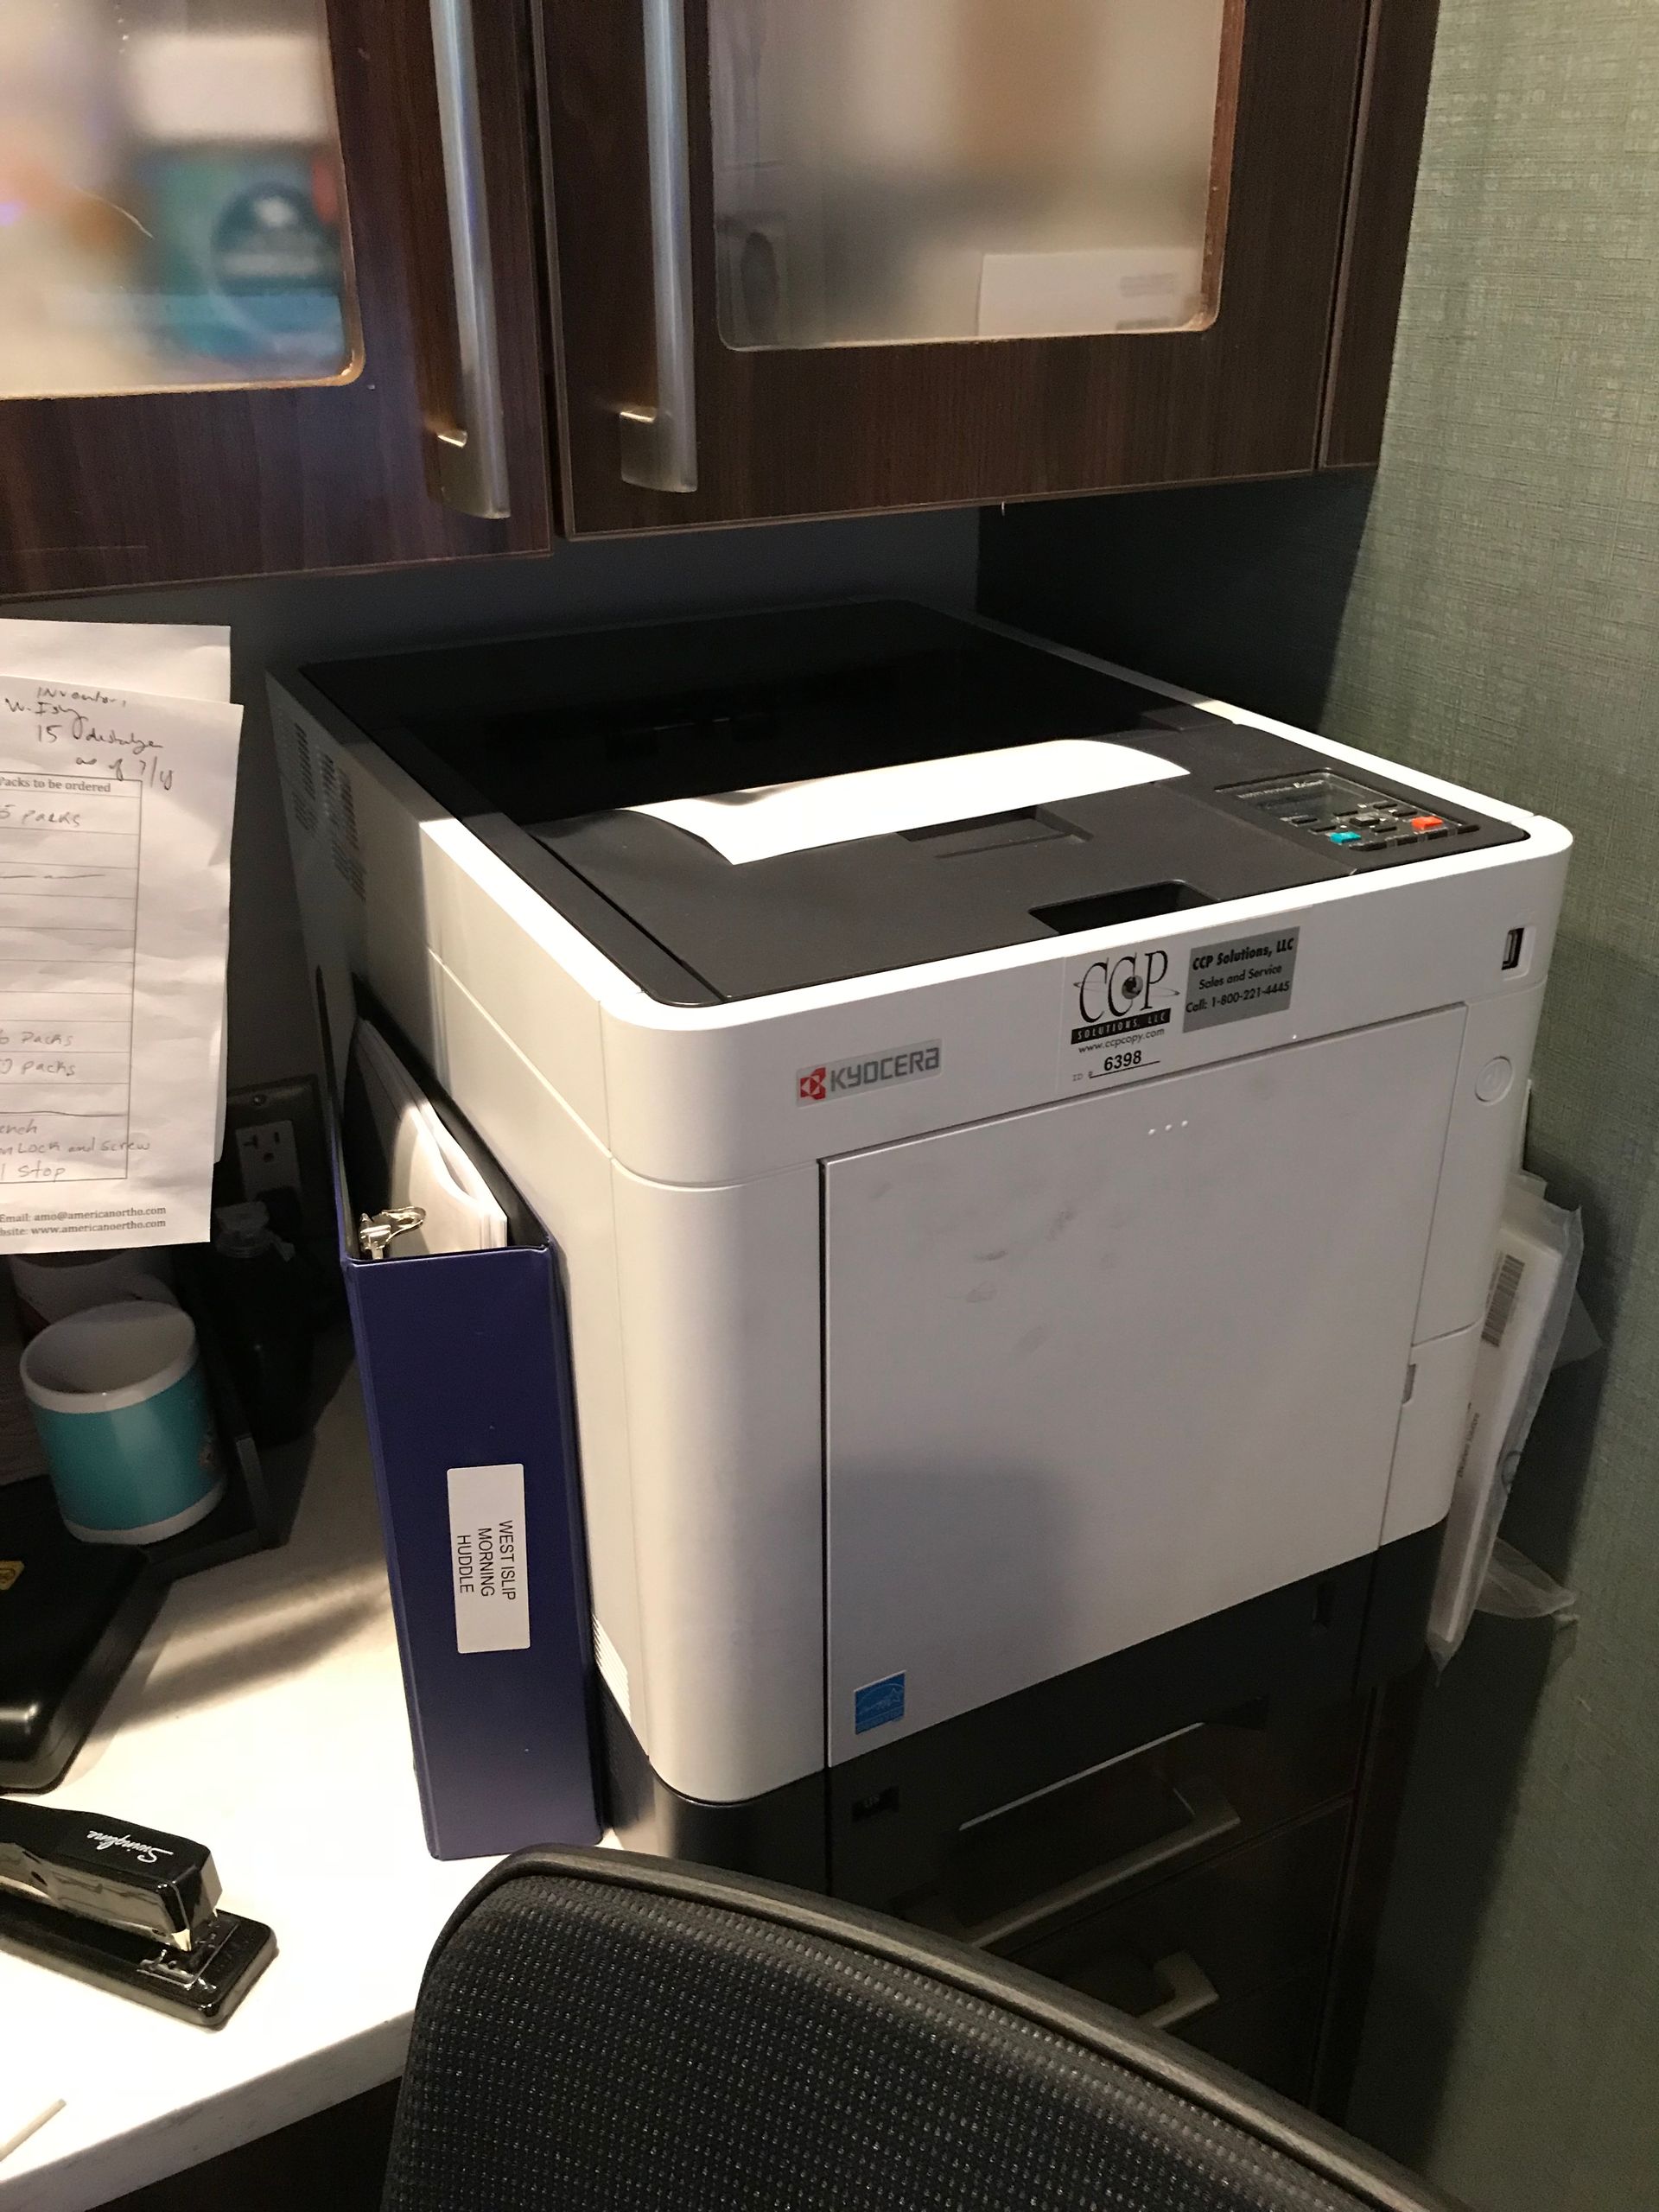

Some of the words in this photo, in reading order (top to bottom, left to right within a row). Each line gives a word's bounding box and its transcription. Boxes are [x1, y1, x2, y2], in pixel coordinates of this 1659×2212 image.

[33, 779, 46, 788] to
[48, 779, 62, 789] be
[65, 781, 111, 793] ordered
[1192, 955, 1214, 970] CCP
[1217, 946, 1272, 966] Solutions,
[1276, 938, 1294, 953] LLC
[1079, 950, 1169, 1023] CCP
[1198, 976, 1224, 990] Sales
[1226, 969, 1246, 984] and
[1248, 963, 1282, 979] Service
[1147, 1012, 1167, 1026] LLC
[1185, 998, 1208, 1013] Call:
[1078, 1027, 1166, 1053] www.ccpcopy.com
[830, 1046, 940, 1092] KYOCERA
[1103, 1050, 1142, 1071] 6398
[0, 1213, 31, 1223] Email:
[34, 1206, 166, 1222] amo@americanortho.com
[499, 1520, 515, 1562] WEST
[457, 1535, 474, 1593] HUDDLE
[478, 1528, 495, 1597] MORNING
[501, 1567, 516, 1600] ISLIP
[86, 1830, 174, 1863] Swingline
